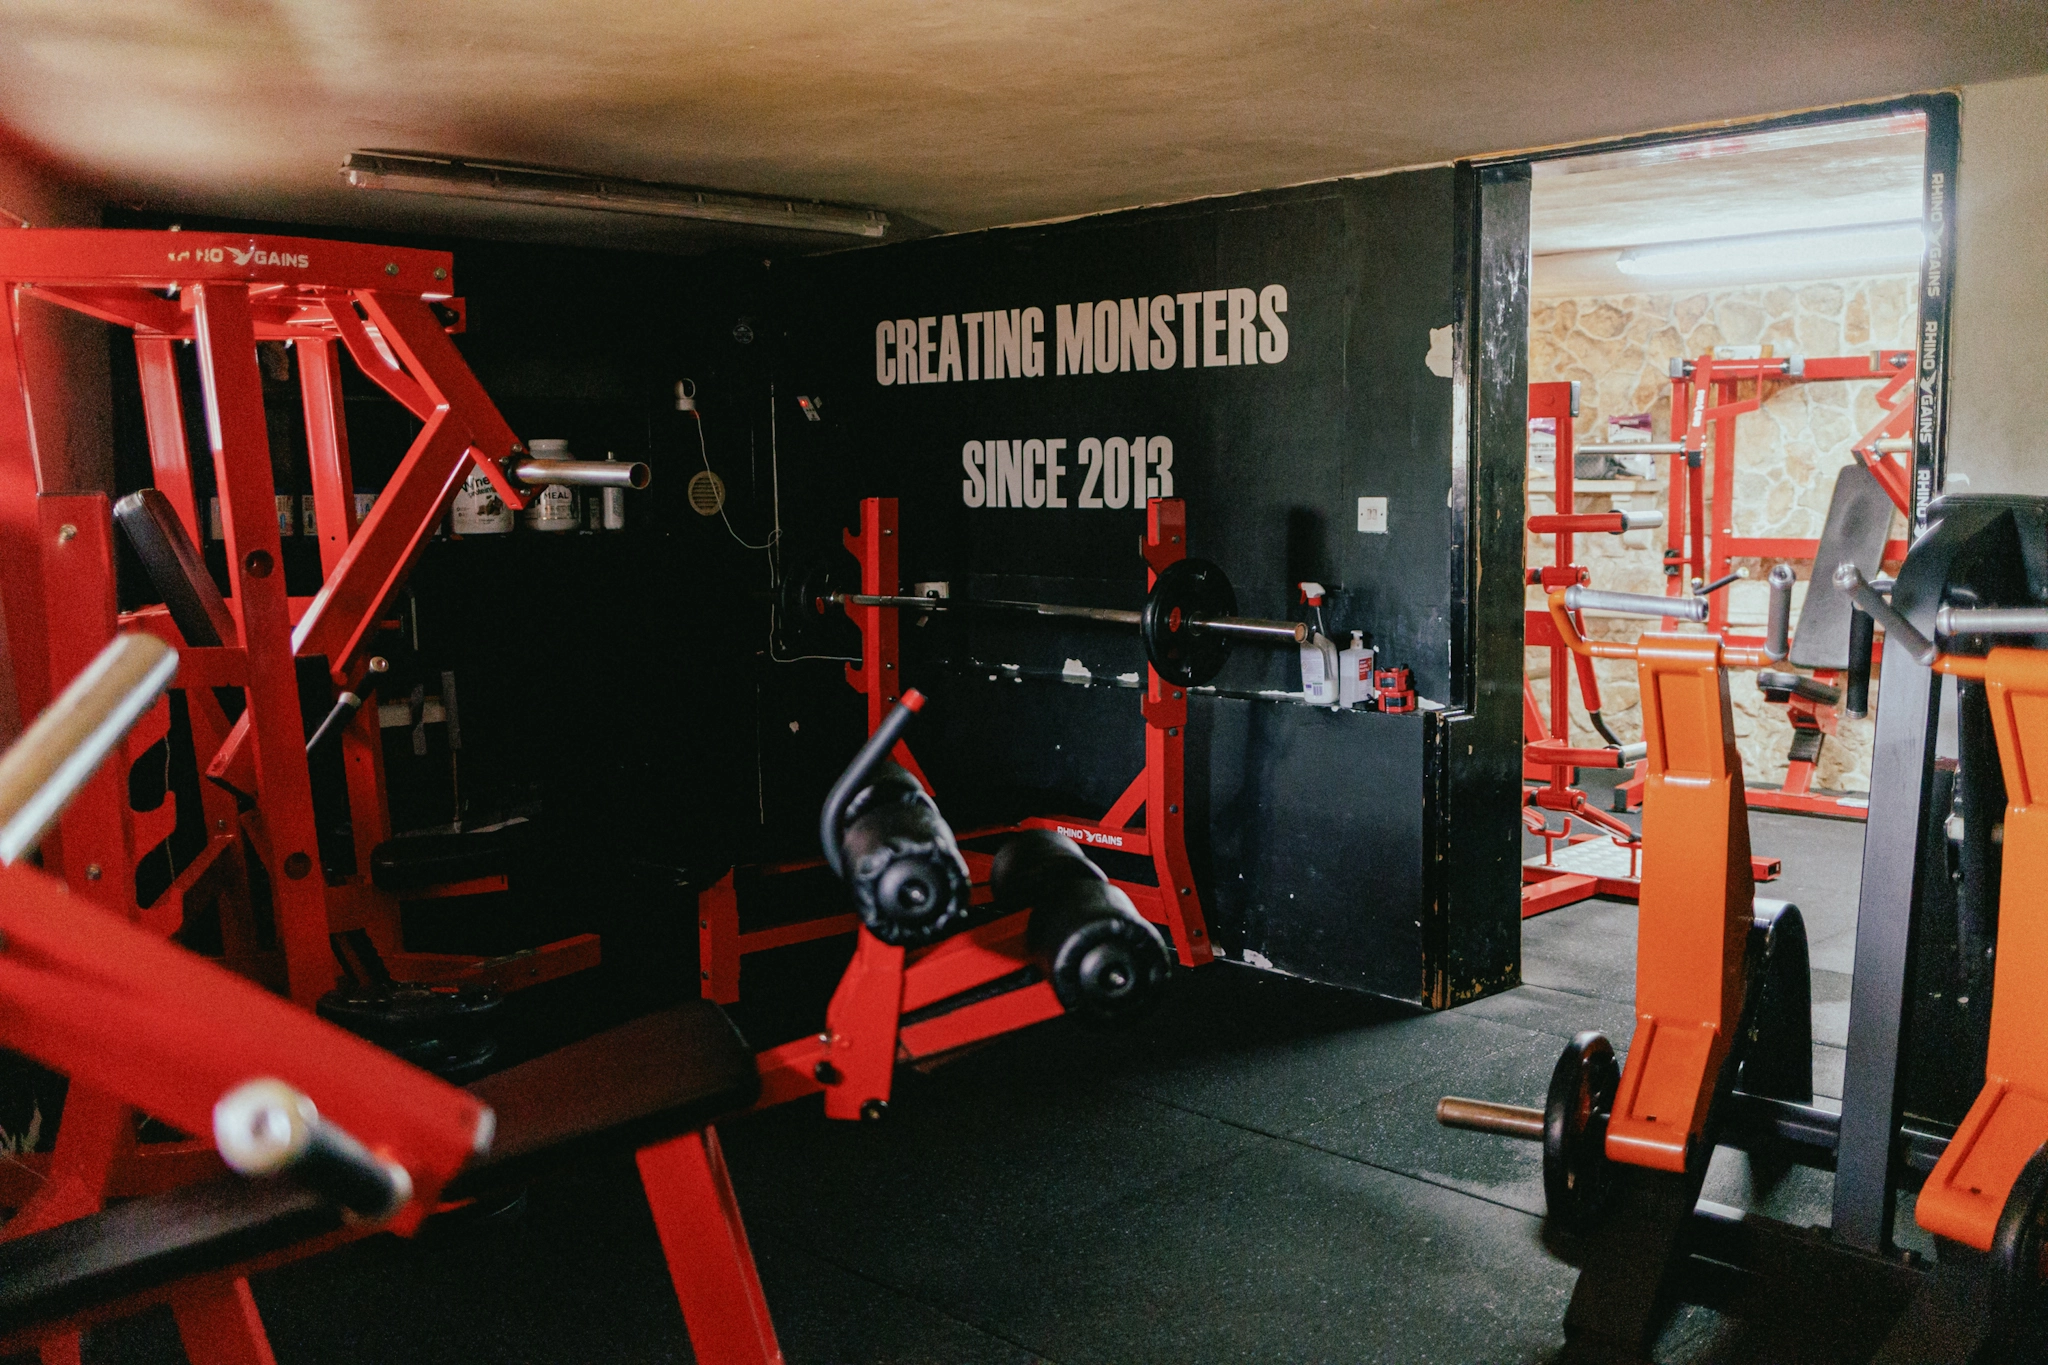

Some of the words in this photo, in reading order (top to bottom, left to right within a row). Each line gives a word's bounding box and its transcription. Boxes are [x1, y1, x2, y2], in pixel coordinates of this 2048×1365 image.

[1931, 172, 1945, 222] RHINO
[254, 250, 309, 268] GAINS
[1927, 246, 1942, 297] GAINS
[876, 307, 1045, 386] CREATING
[1056, 284, 1289, 375] MONSTERS
[1922, 321, 1938, 370] RHINO
[1919, 395, 1934, 444] GAINS
[962, 438, 1067, 508] SINCE
[1078, 436, 1174, 509] 2013
[1916, 469, 1930, 518] RHINO
[1057, 825, 1083, 840] RHINO
[1095, 833, 1123, 847] GAINS
